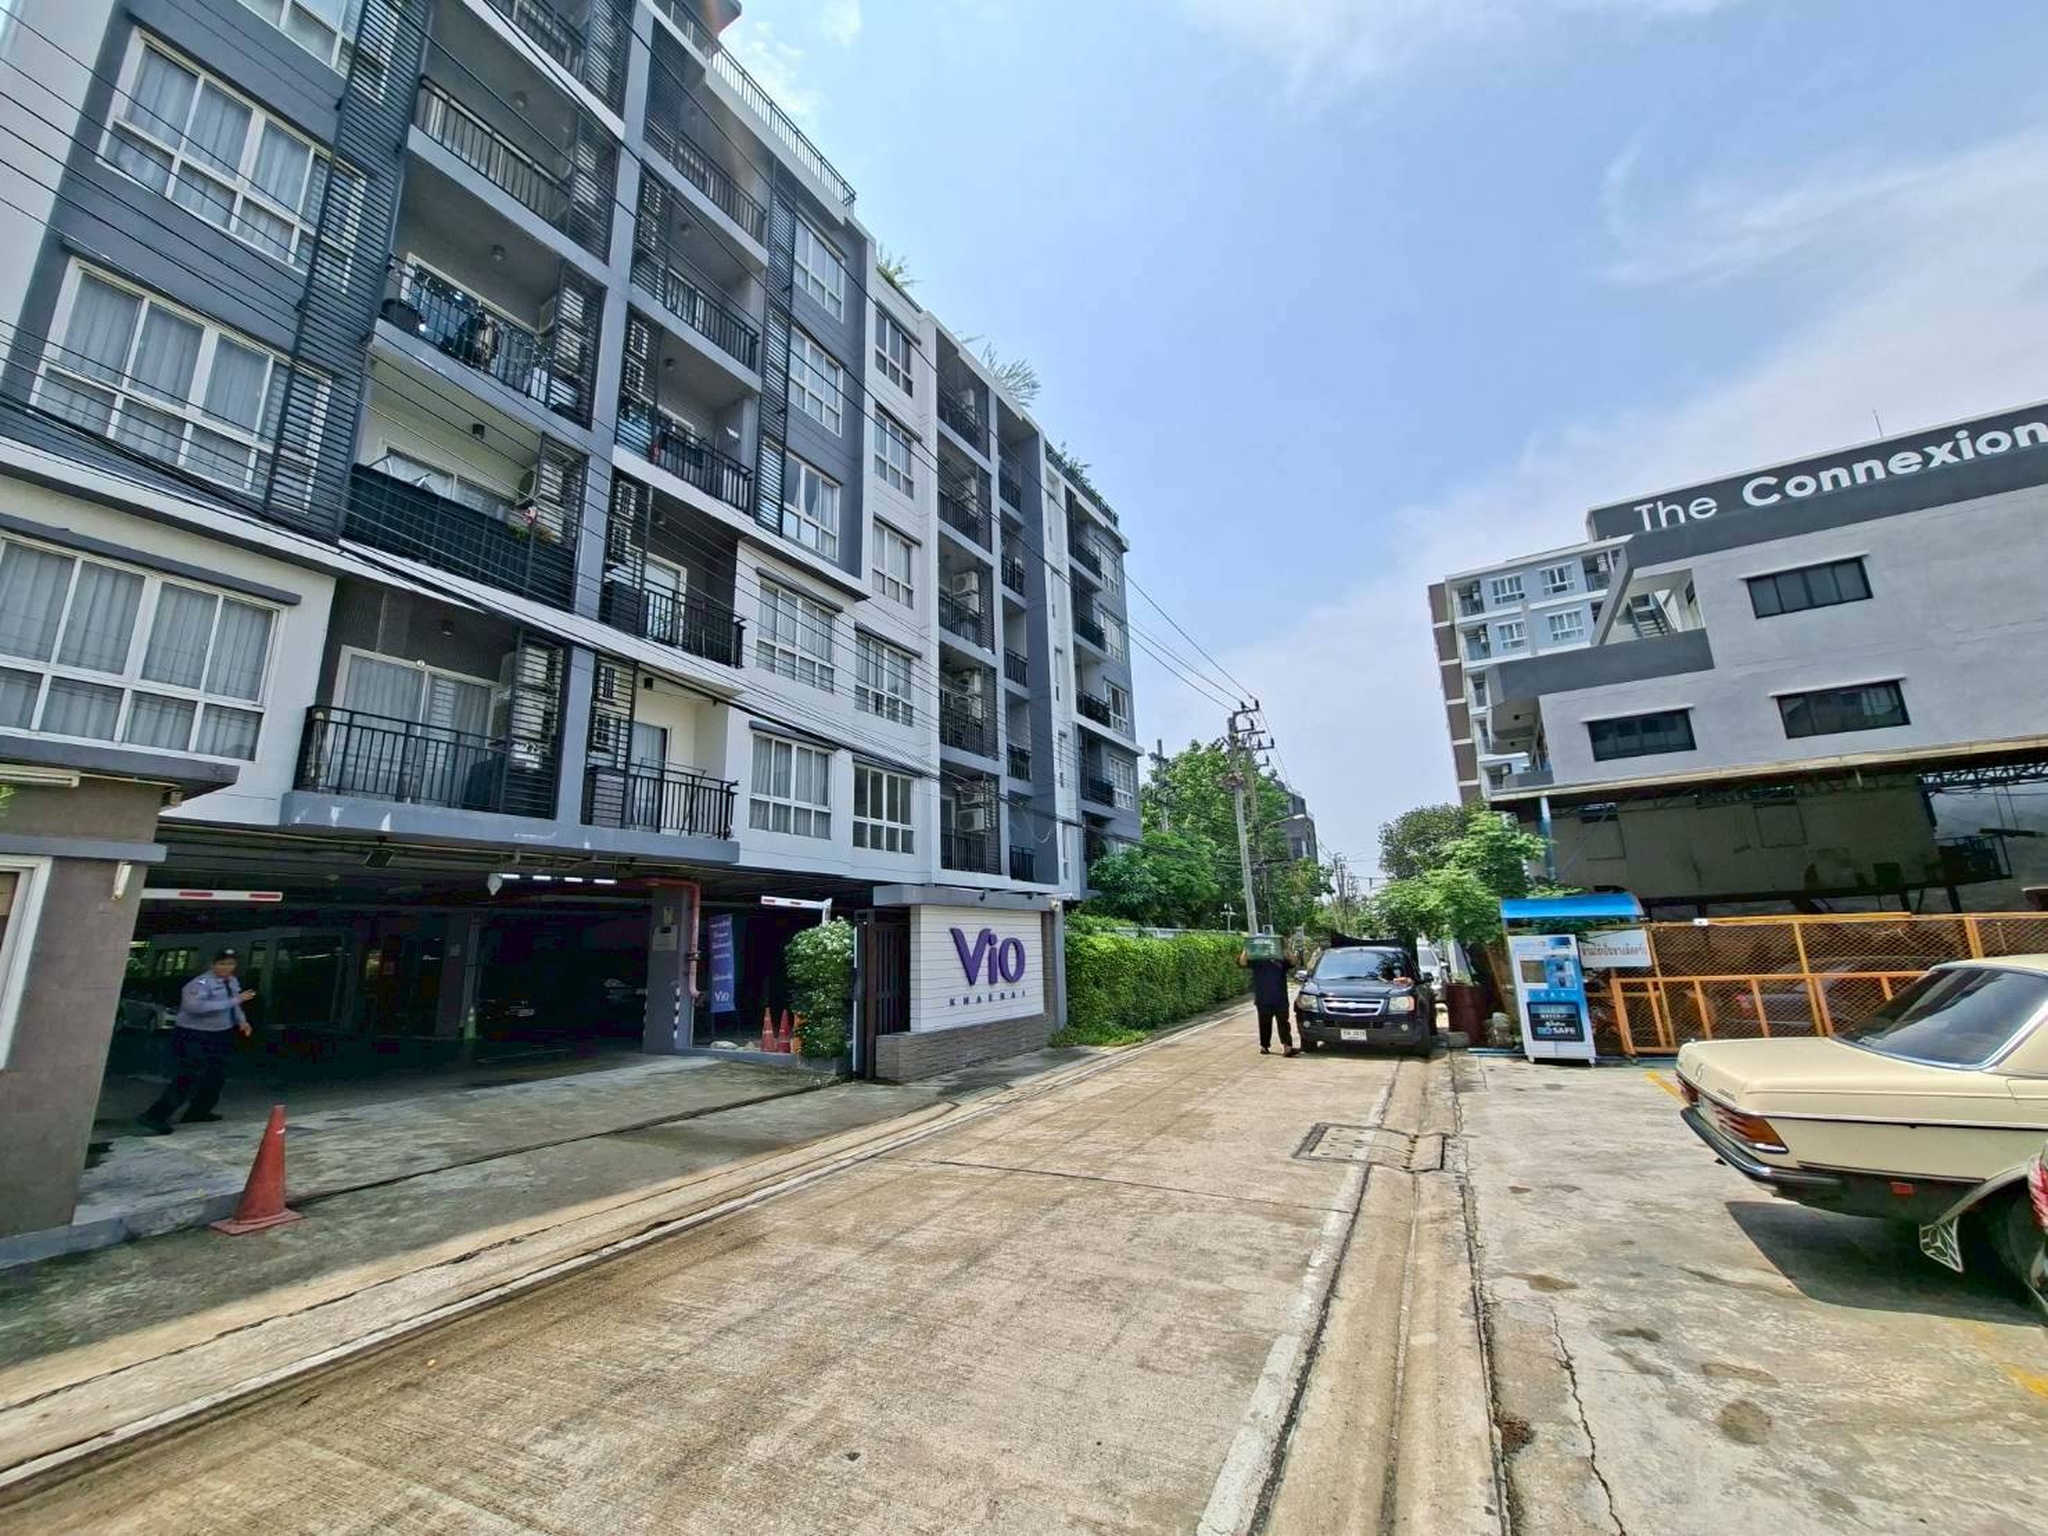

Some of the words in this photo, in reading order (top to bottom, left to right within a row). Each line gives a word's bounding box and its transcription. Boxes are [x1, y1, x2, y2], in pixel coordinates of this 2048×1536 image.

[1633, 497, 1718, 533] The
[1741, 420, 2048, 507] Connexion
[950, 928, 1026, 986] Vio
